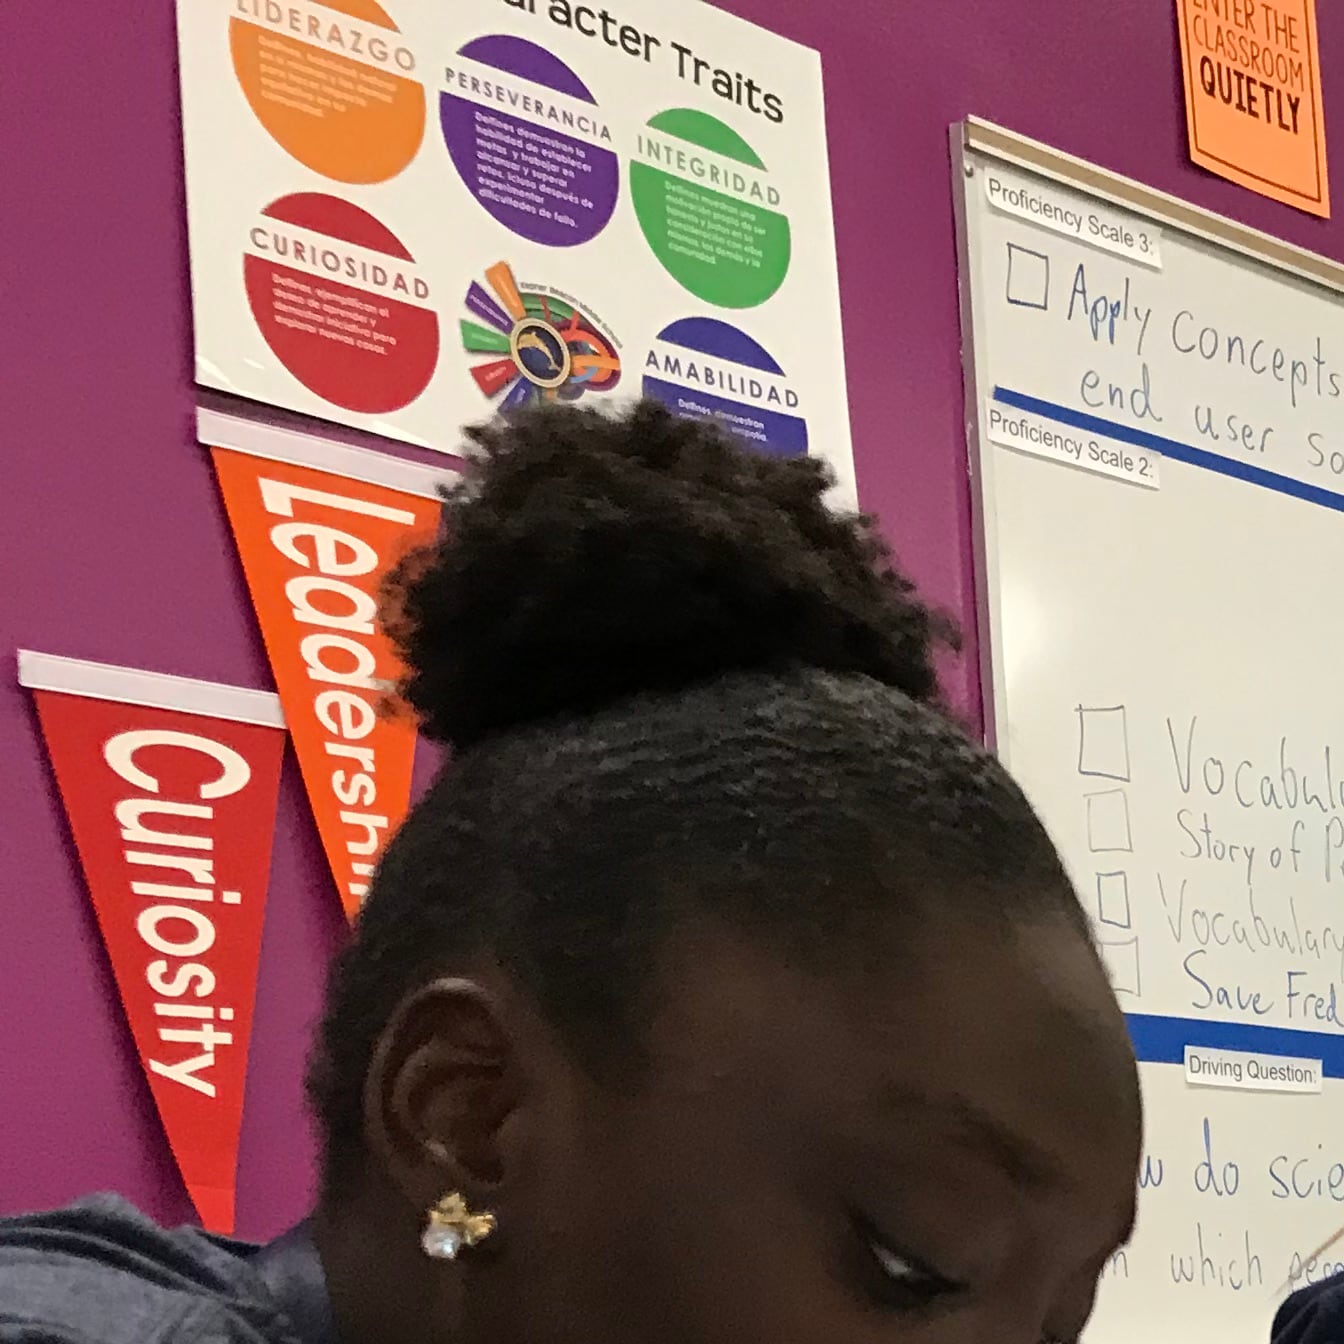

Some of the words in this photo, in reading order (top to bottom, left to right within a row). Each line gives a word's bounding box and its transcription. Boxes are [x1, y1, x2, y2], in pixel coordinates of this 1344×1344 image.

[237, 0, 416, 71] LIDERAZGO
[1193, 15, 1304, 92] CLASSROOM
[1194, 0, 1256, 34] TER
[1261, 3, 1300, 54] THE
[445, 67, 612, 142] PERSEVERANCIA
[671, 42, 784, 123] Traits
[1200, 55, 1300, 135] QUIETLY
[637, 134, 780, 205] INTEGRIDAD
[988, 178, 1083, 233] Proficiency
[1087, 214, 1134, 248] Scale
[1138, 234, 1153, 254] 3:
[250, 228, 429, 299] CURIOSIDAD
[1066, 263, 1152, 355] Apply
[646, 350, 799, 407] AMABILIDAD
[1080, 363, 1162, 423] end
[1195, 403, 1274, 453] user
[988, 410, 1083, 461] Proficiency
[1087, 446, 1134, 476] Scale
[1137, 457, 1153, 478] 2:
[258, 475, 416, 905] Leadershi
[1177, 808, 1254, 879] Story
[1270, 820, 1305, 872] of
[104, 728, 252, 1097] Curiosity
[1183, 948, 1275, 1016] Save
[1188, 1055, 1243, 1083] Driving
[1246, 1061, 1318, 1085] Question:
[1195, 1117, 1240, 1198] do
[1171, 1223, 1262, 1290] which
